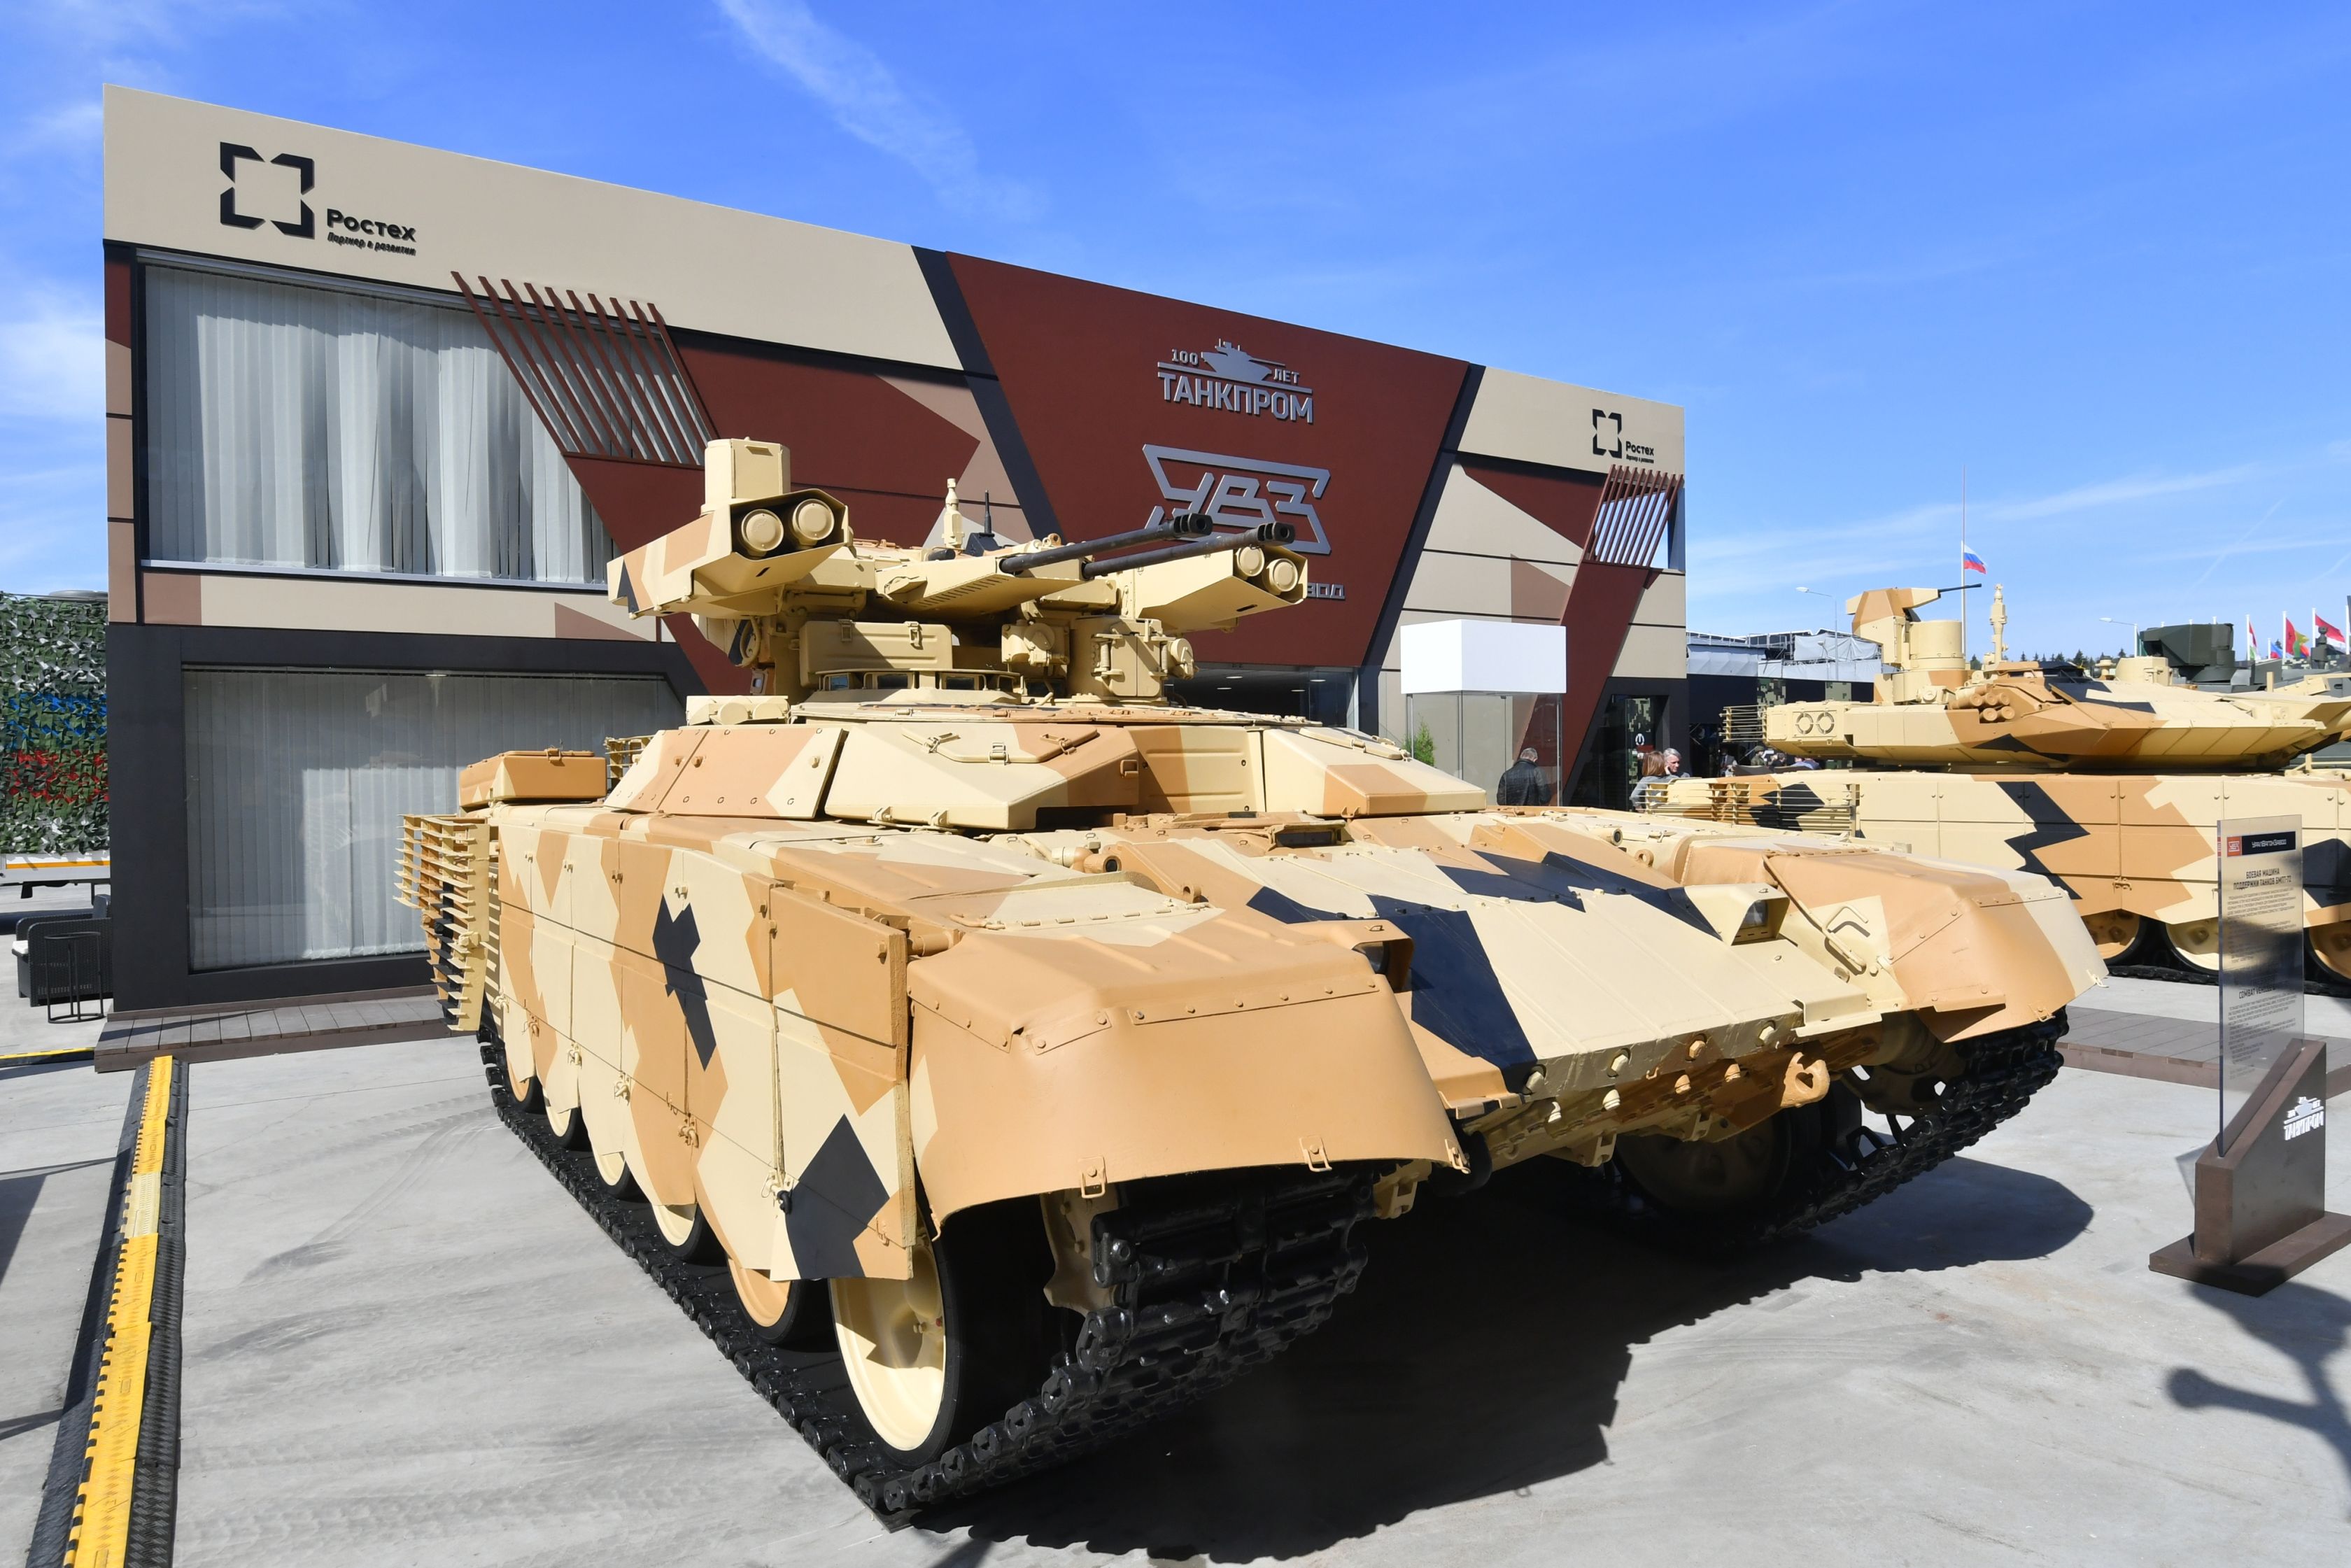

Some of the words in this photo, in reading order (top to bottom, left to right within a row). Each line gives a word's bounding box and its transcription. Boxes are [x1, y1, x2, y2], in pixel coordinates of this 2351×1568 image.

[327, 208, 417, 243] Ростех
[327, 232, 366, 249] Партнер
[1172, 348, 1199, 366] 100
[1273, 368, 1299, 385] ЛЕТ
[1157, 372, 1314, 424] ТАНКПРОМ
[1625, 440, 1654, 456] Ростех
